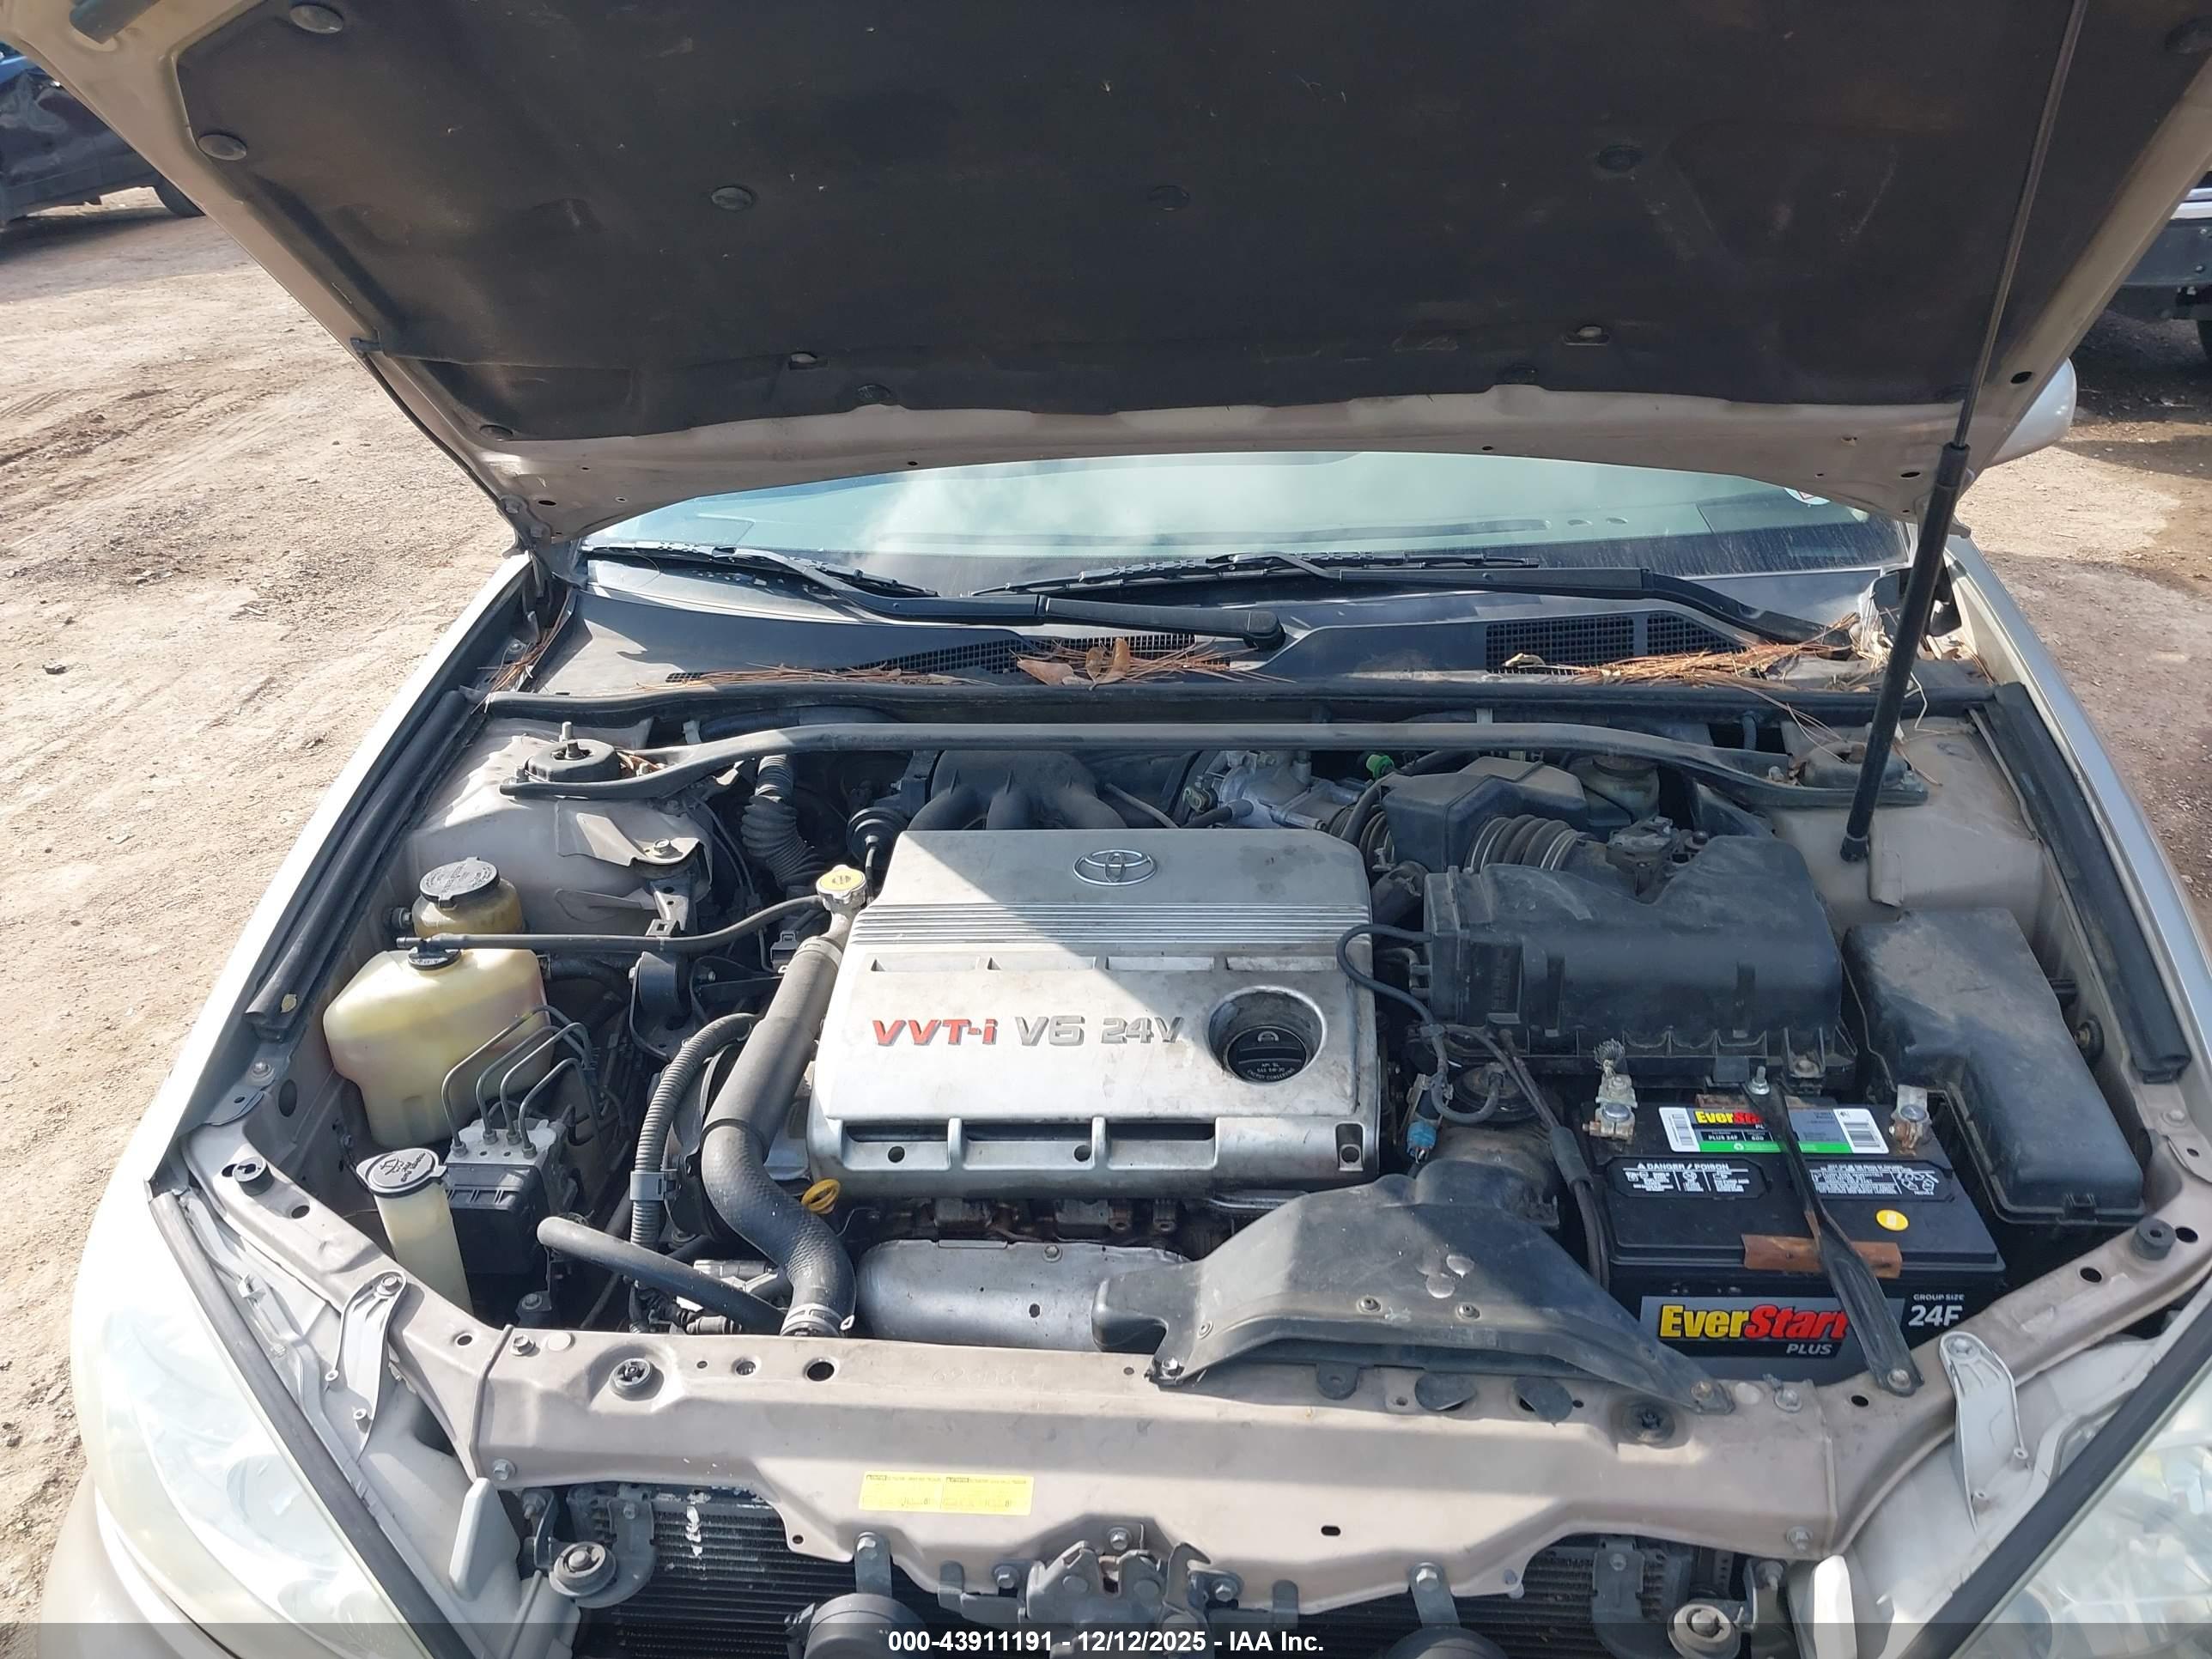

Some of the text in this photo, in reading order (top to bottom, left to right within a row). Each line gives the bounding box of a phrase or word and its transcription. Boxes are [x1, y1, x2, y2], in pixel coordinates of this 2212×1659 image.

[872, 1015, 1185, 1047] VVT-i V6 24V
[1659, 1304, 1849, 1340] EverStart
[1908, 1304, 1963, 1327] 24F
[1786, 1343, 1832, 1356] PLUS
